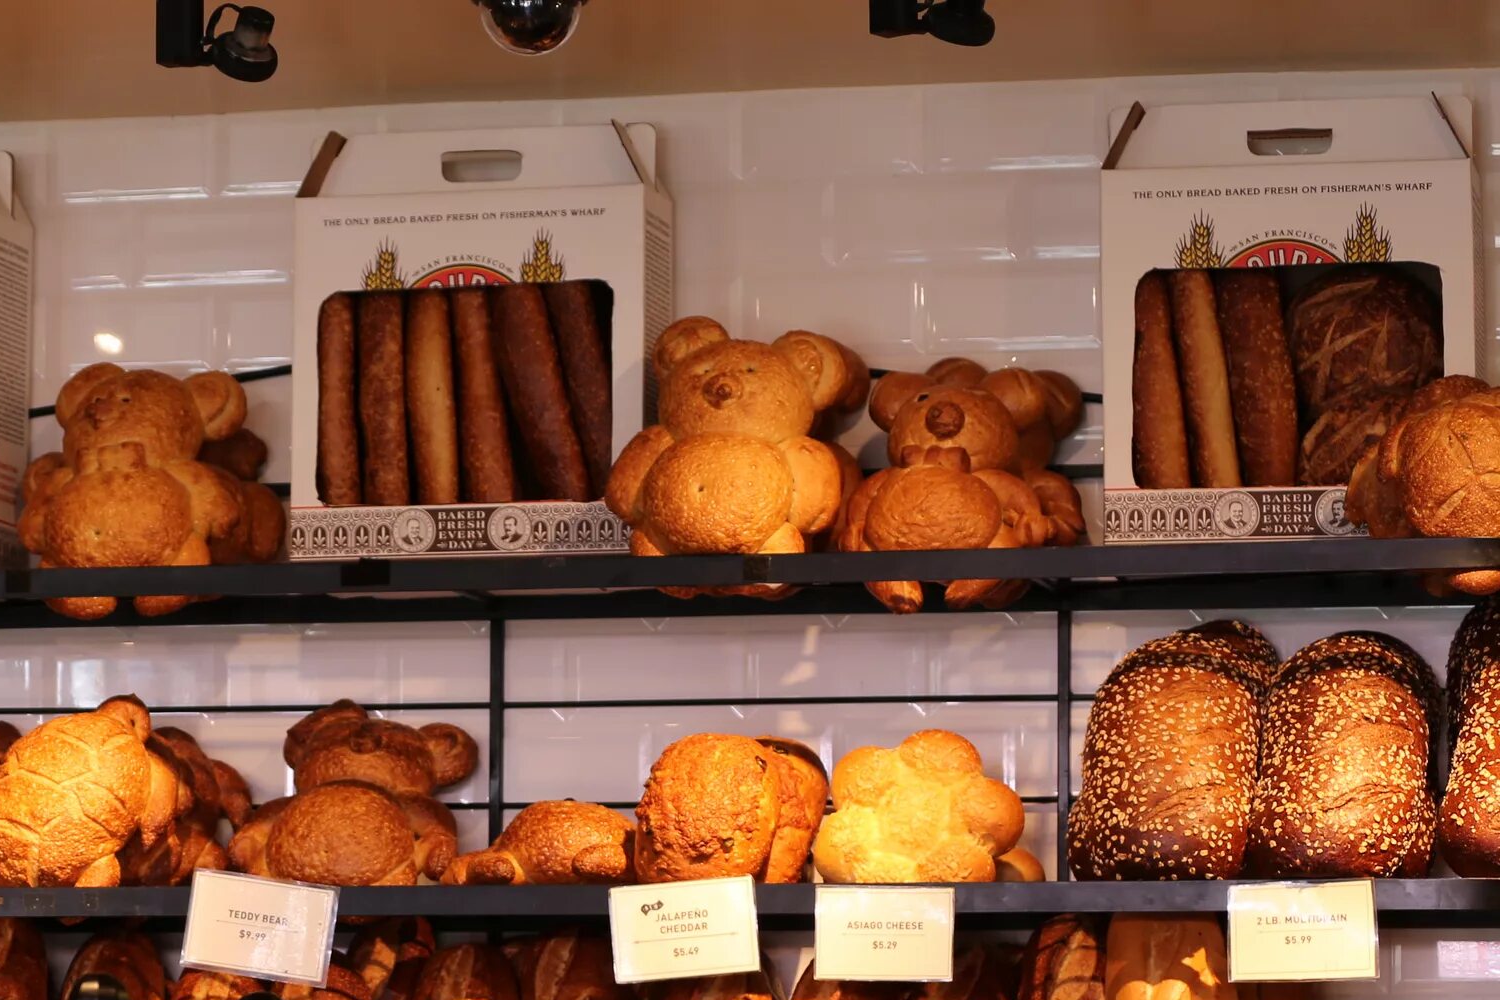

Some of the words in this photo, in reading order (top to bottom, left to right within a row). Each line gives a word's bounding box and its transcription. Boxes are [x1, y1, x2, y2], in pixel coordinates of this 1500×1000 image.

[1132, 190, 1153, 200] THE
[1156, 190, 1183, 199] ONLY
[1186, 188, 1222, 198] BREAD
[1224, 187, 1261, 197] BAKED
[1264, 186, 1299, 195] FRESH
[1302, 185, 1318, 194] ON
[1320, 182, 1393, 194] FISHERMAN'S
[1395, 182, 1434, 192] WHARF
[323, 218, 342, 227] THE
[345, 217, 370, 226] ONLY
[374, 216, 407, 225] BREAD
[410, 214, 444, 224] BAKED
[446, 212, 480, 222] FRESH
[482, 212, 498, 220] ON
[500, 208, 568, 220] FISHERMAN'S
[570, 208, 607, 217] WHARF
[1238, 233, 1260, 248] SAN
[1264, 229, 1328, 245] FRANCISCO
[421, 260, 440, 272] SAN
[445, 254, 506, 270] FRANCISCO
[1262, 494, 1312, 503] BAKED
[1262, 504, 1312, 514] FRESH
[438, 510, 486, 520] BAKED
[1263, 514, 1312, 524] EVERY
[438, 520, 486, 530] FRESH
[1274, 524, 1301, 534] DAY
[438, 530, 485, 540] EVERY
[449, 540, 475, 549] DAY
[228, 909, 260, 922] TEDDY
[262, 914, 288, 926] BEAR
[1257, 917, 1262, 925] 2
[660, 922, 708, 934] CHEDDAR
[847, 921, 883, 930] ASIAGO
[886, 921, 924, 930] CHEESE
[239, 930, 266, 942] $9.99
[1285, 936, 1312, 945] $5.99
[872, 940, 898, 950] $5.29
[673, 946, 699, 958] $5.49
